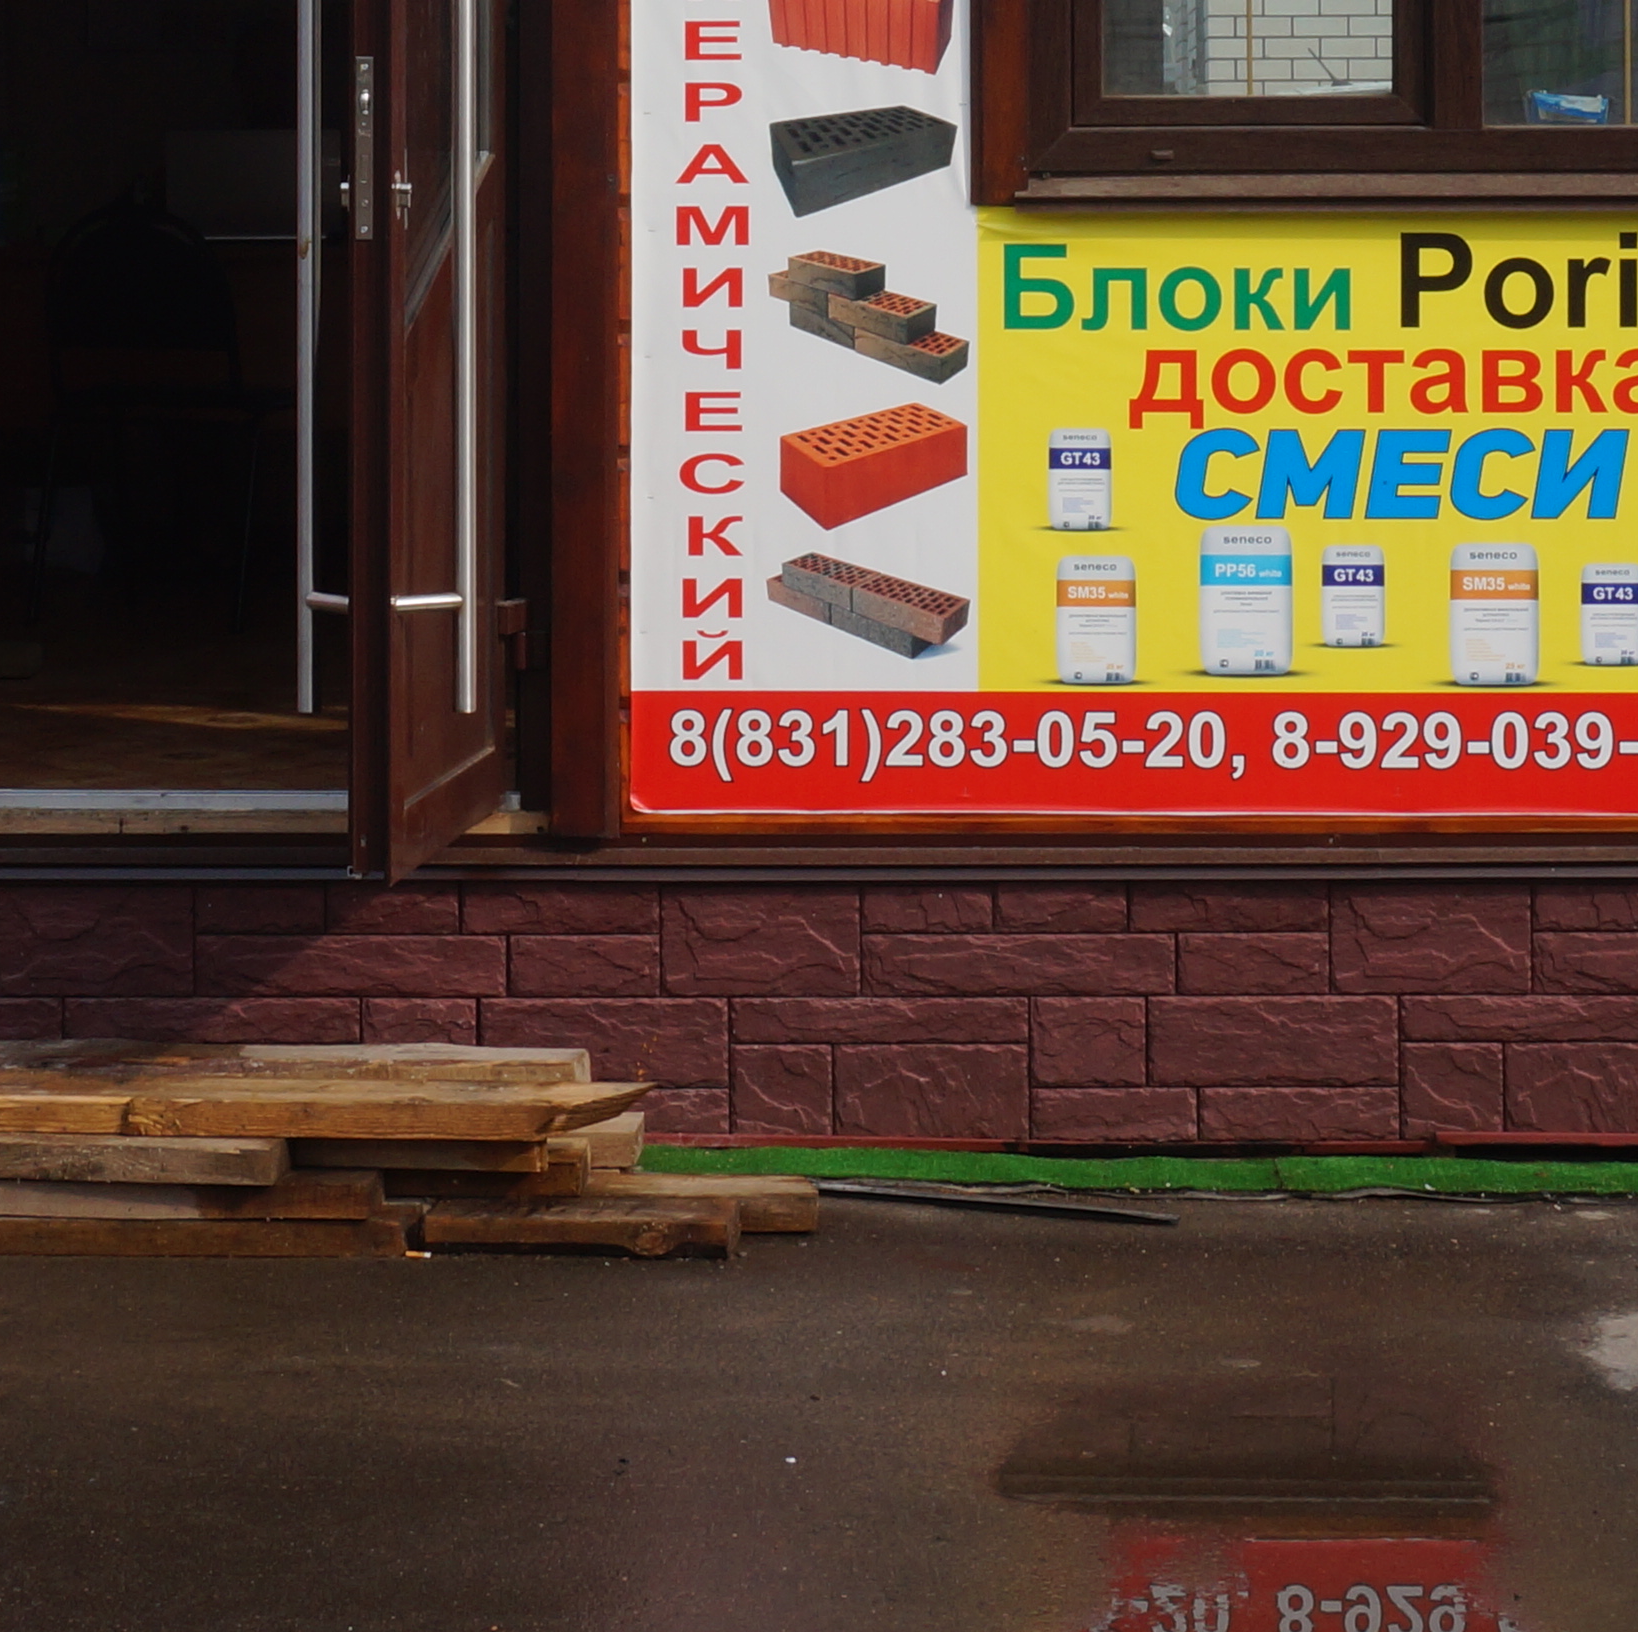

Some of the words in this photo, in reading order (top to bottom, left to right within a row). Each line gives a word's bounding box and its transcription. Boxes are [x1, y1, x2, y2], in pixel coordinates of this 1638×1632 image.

[1003, 243, 1351, 331] Блоки
[1060, 452, 1101, 466] GT43
[1174, 427, 1630, 520] СМЕСИ
[1223, 535, 1272, 544] seneco
[1469, 551, 1517, 560] seneco
[1074, 563, 1117, 571] seneco
[1215, 564, 1256, 578] PP56
[1334, 569, 1374, 582] GT43
[1463, 577, 1505, 591] SM35
[1067, 587, 1106, 600] SM35
[1593, 587, 1633, 601] GT43
[669, 709, 1245, 781] 8(831)283-05-20,
